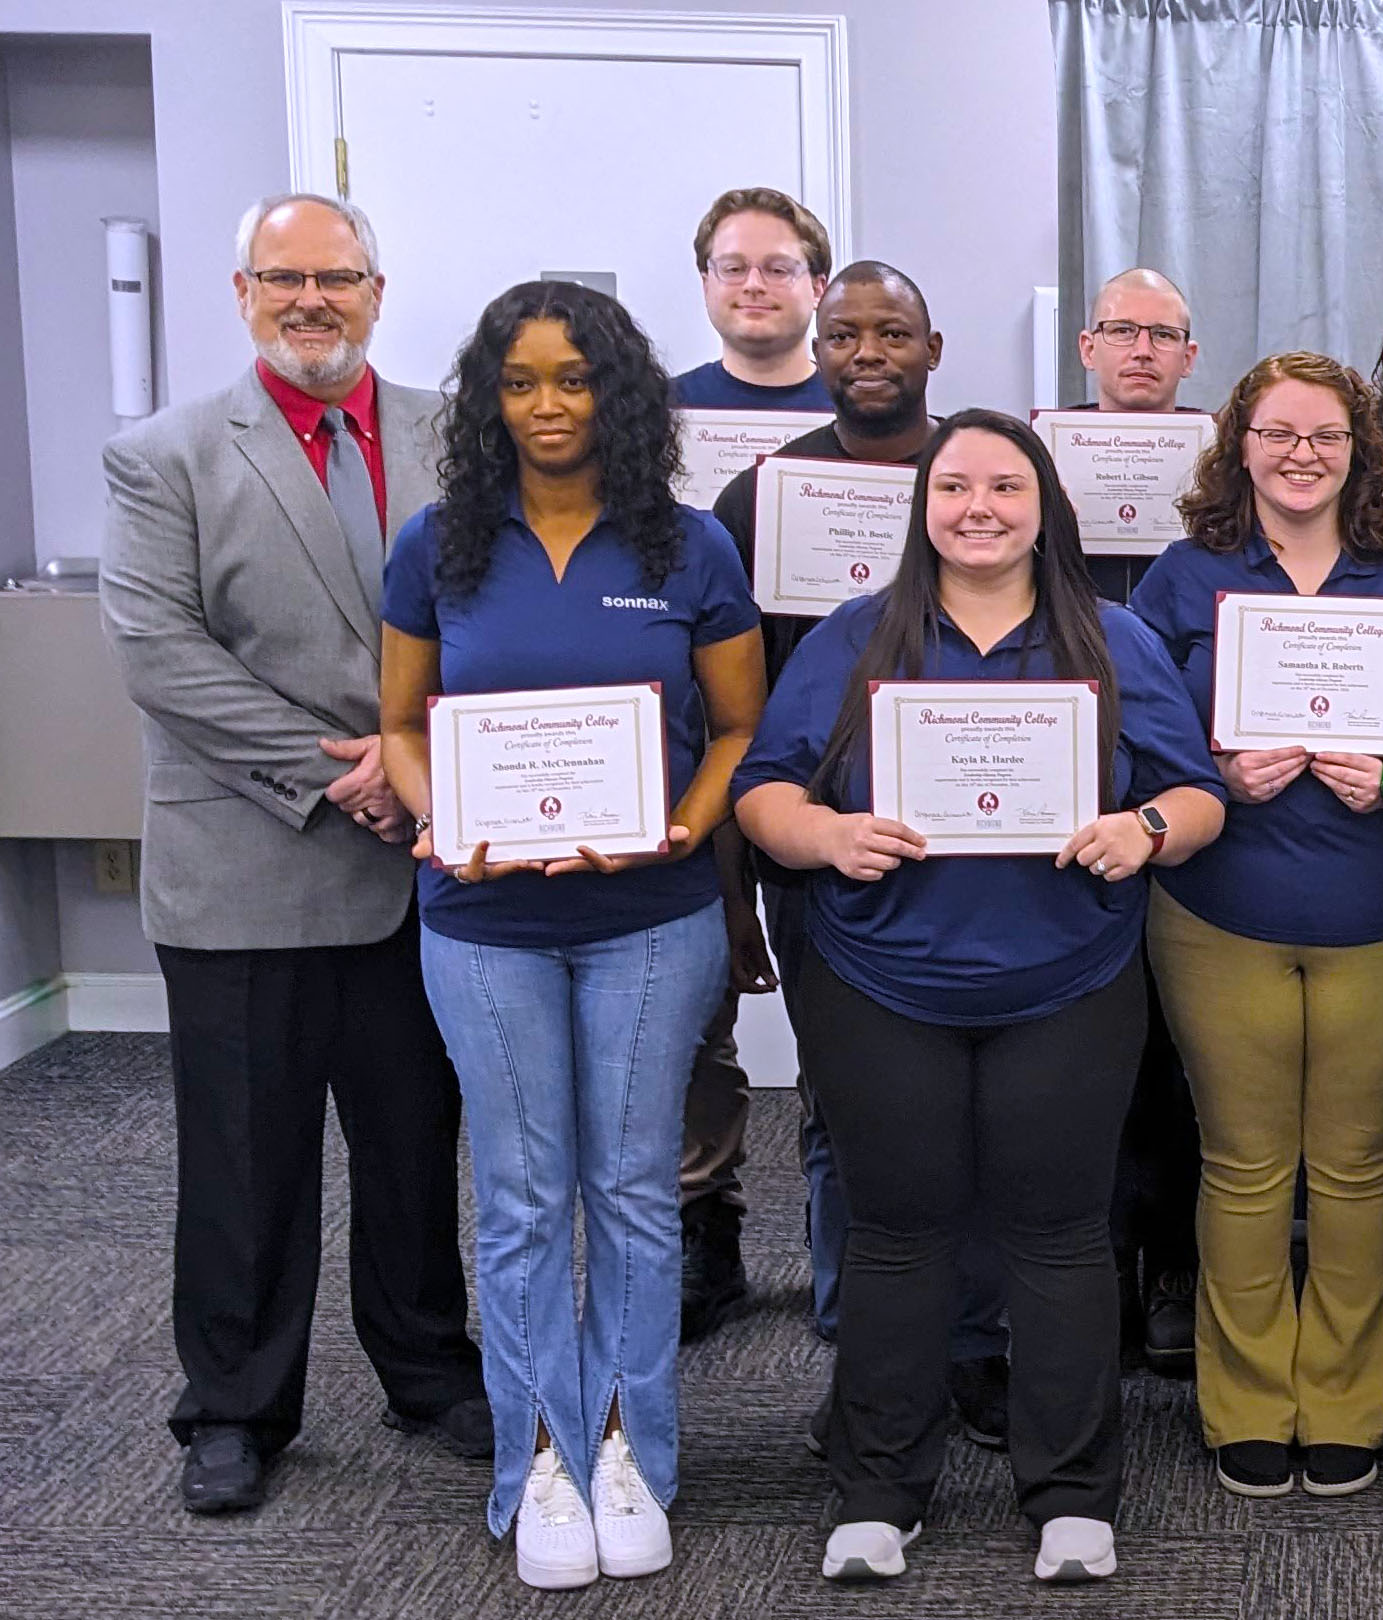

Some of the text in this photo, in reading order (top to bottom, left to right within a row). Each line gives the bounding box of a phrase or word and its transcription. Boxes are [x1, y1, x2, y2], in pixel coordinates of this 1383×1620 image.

[697, 429, 738, 442] Richmond
[740, 432, 781, 445] Community
[1071, 433, 1185, 449] Richmond Community College
[1092, 455, 1122, 464] Certificate
[1132, 455, 1164, 463] Completion
[799, 482, 845, 500] Richmond
[847, 489, 894, 506] Community
[822, 507, 902, 520] Certificate of Completion
[829, 528, 893, 540] Phillip D. Bostic
[602, 596, 669, 612] sonnax
[1260, 617, 1305, 632] Richmond
[1307, 621, 1354, 636] Community
[1282, 642, 1362, 652] Certificate of Completion
[1278, 661, 1318, 670] Samantha
[1333, 662, 1364, 671] Roberts
[478, 714, 619, 734] Richmond Community College
[919, 709, 1058, 727] Richmond Community College
[504, 738, 593, 751] Certificate of Completion
[945, 734, 1031, 744] Certificate of Completion
[492, 757, 604, 772] Shonda R. McClennahan
[951, 755, 1024, 765] Kayla R. Hardee
